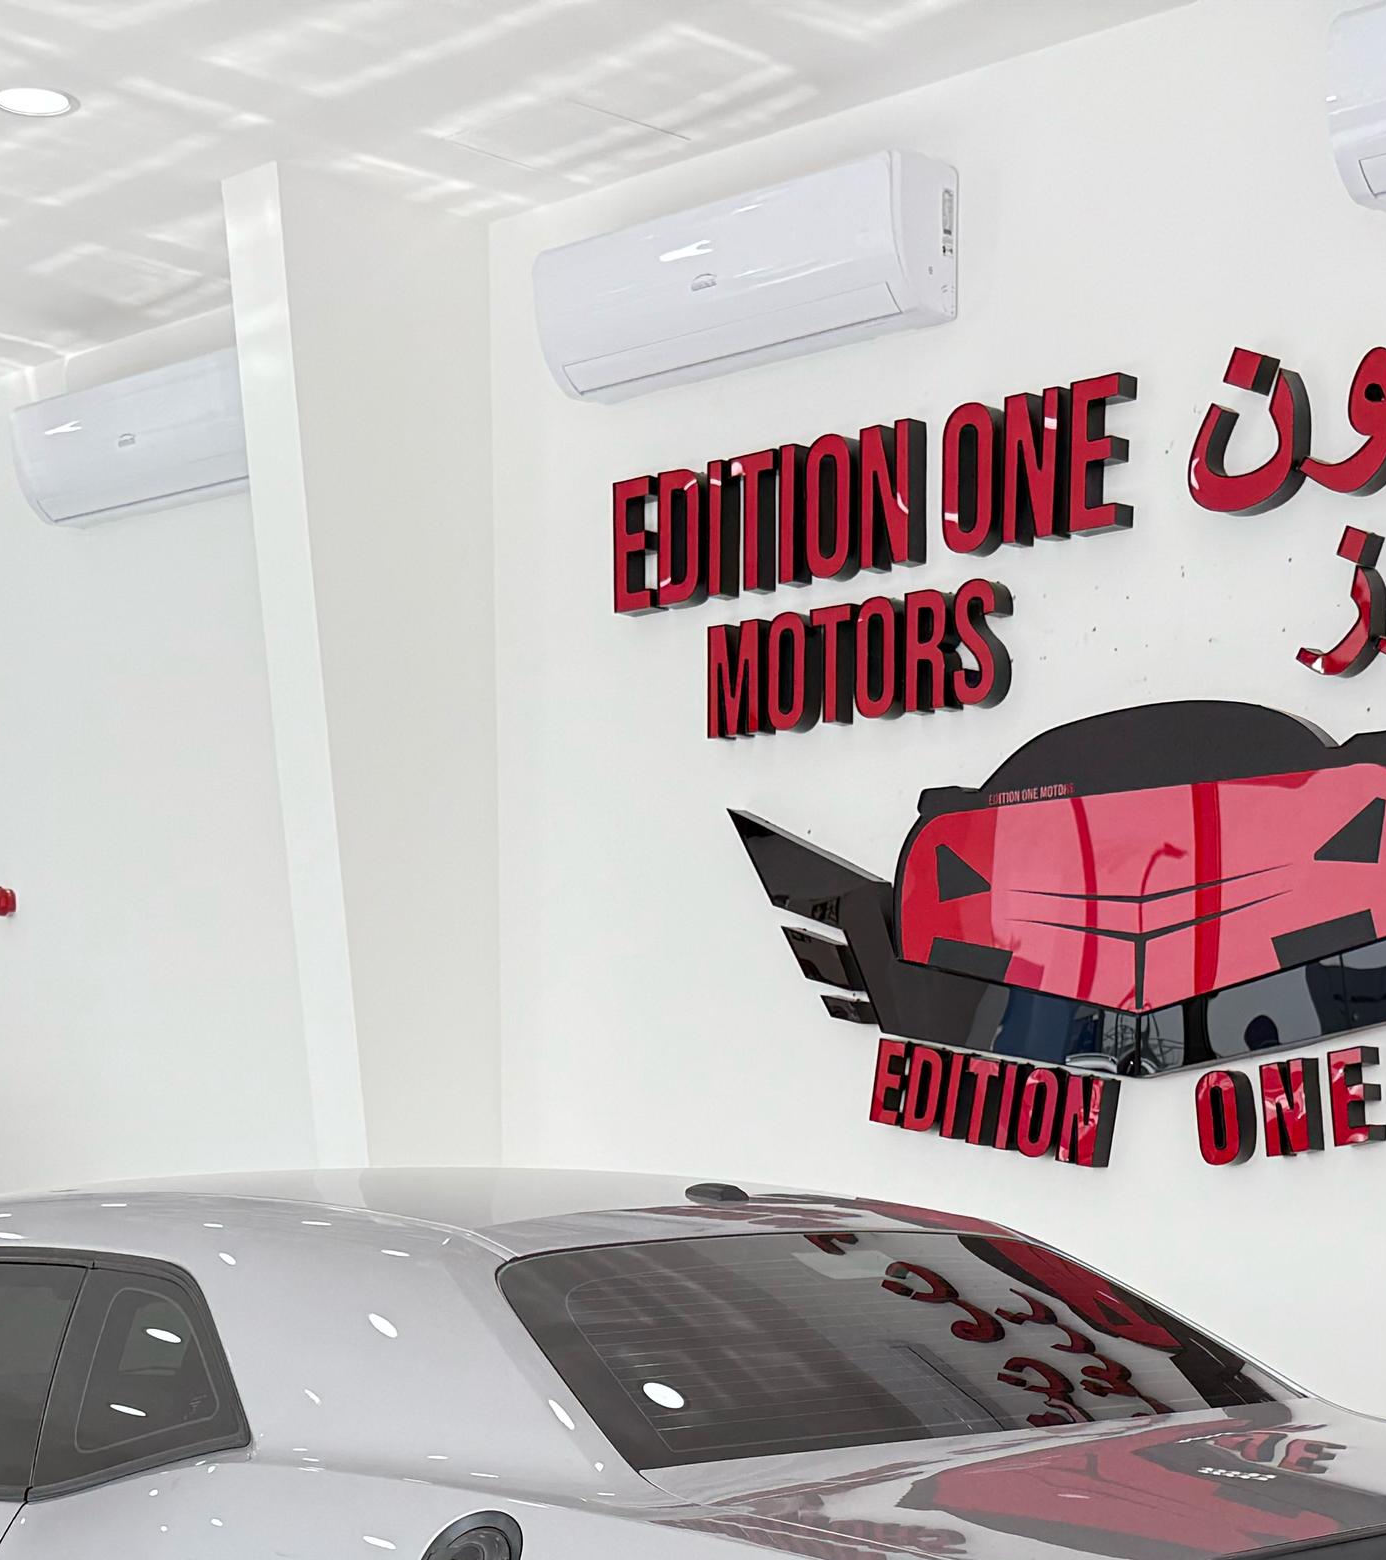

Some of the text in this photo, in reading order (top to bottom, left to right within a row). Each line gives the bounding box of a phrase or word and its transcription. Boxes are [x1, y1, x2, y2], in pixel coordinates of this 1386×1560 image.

[613, 371, 1137, 614] EDITION ONE
[706, 577, 1014, 740] MOTORS
[988, 783, 1075, 806] EDITION ONE MOTORS
[867, 1037, 1386, 1168] EDITION ONE
